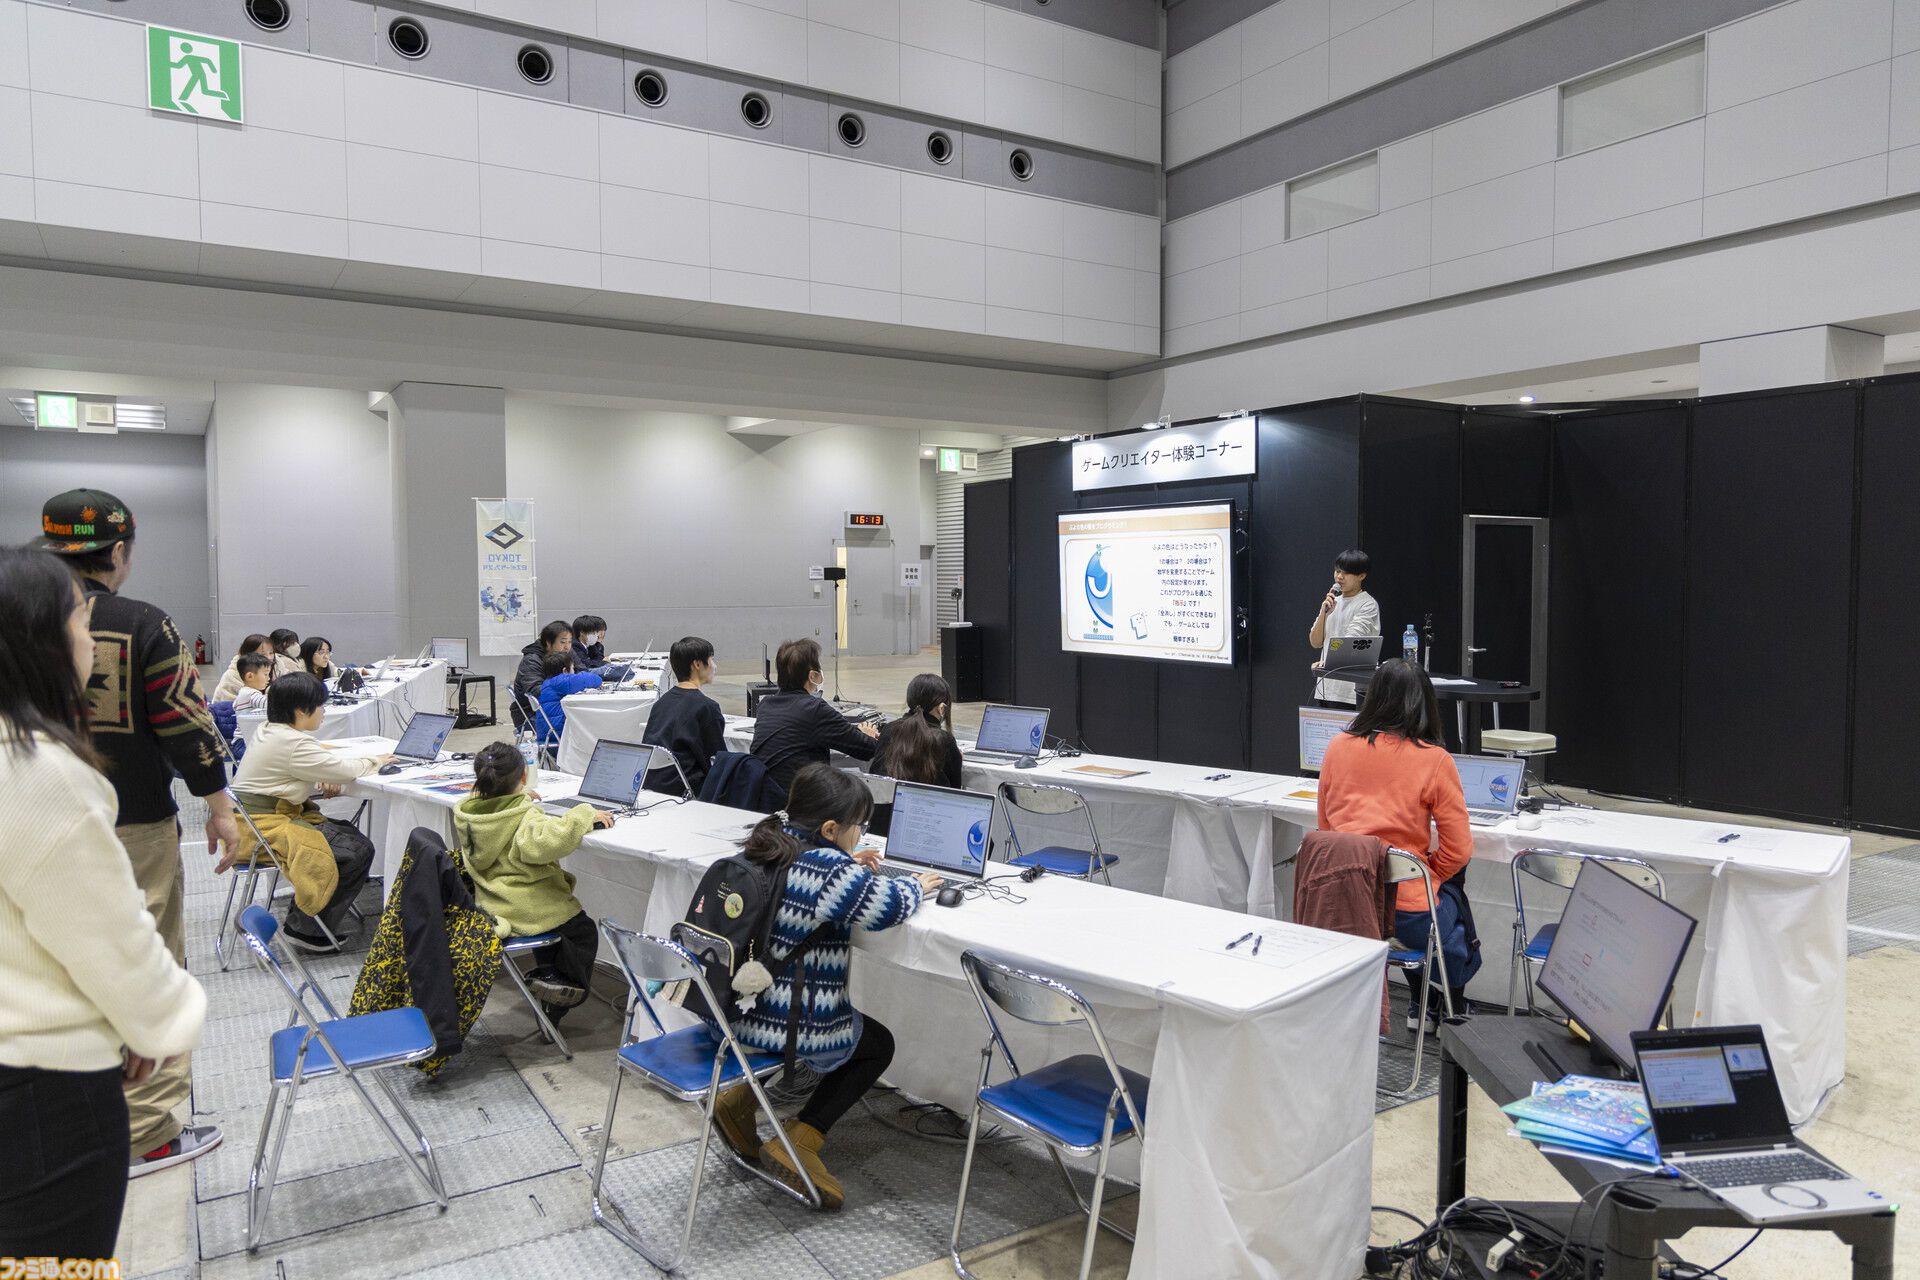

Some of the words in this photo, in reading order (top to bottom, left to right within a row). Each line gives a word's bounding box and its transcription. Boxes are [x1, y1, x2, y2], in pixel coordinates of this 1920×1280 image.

[1082, 441, 1243, 473] ゲームクリエイター体験コーナー
[855, 515, 881, 525] 16:13
[73, 524, 95, 536] RUN
